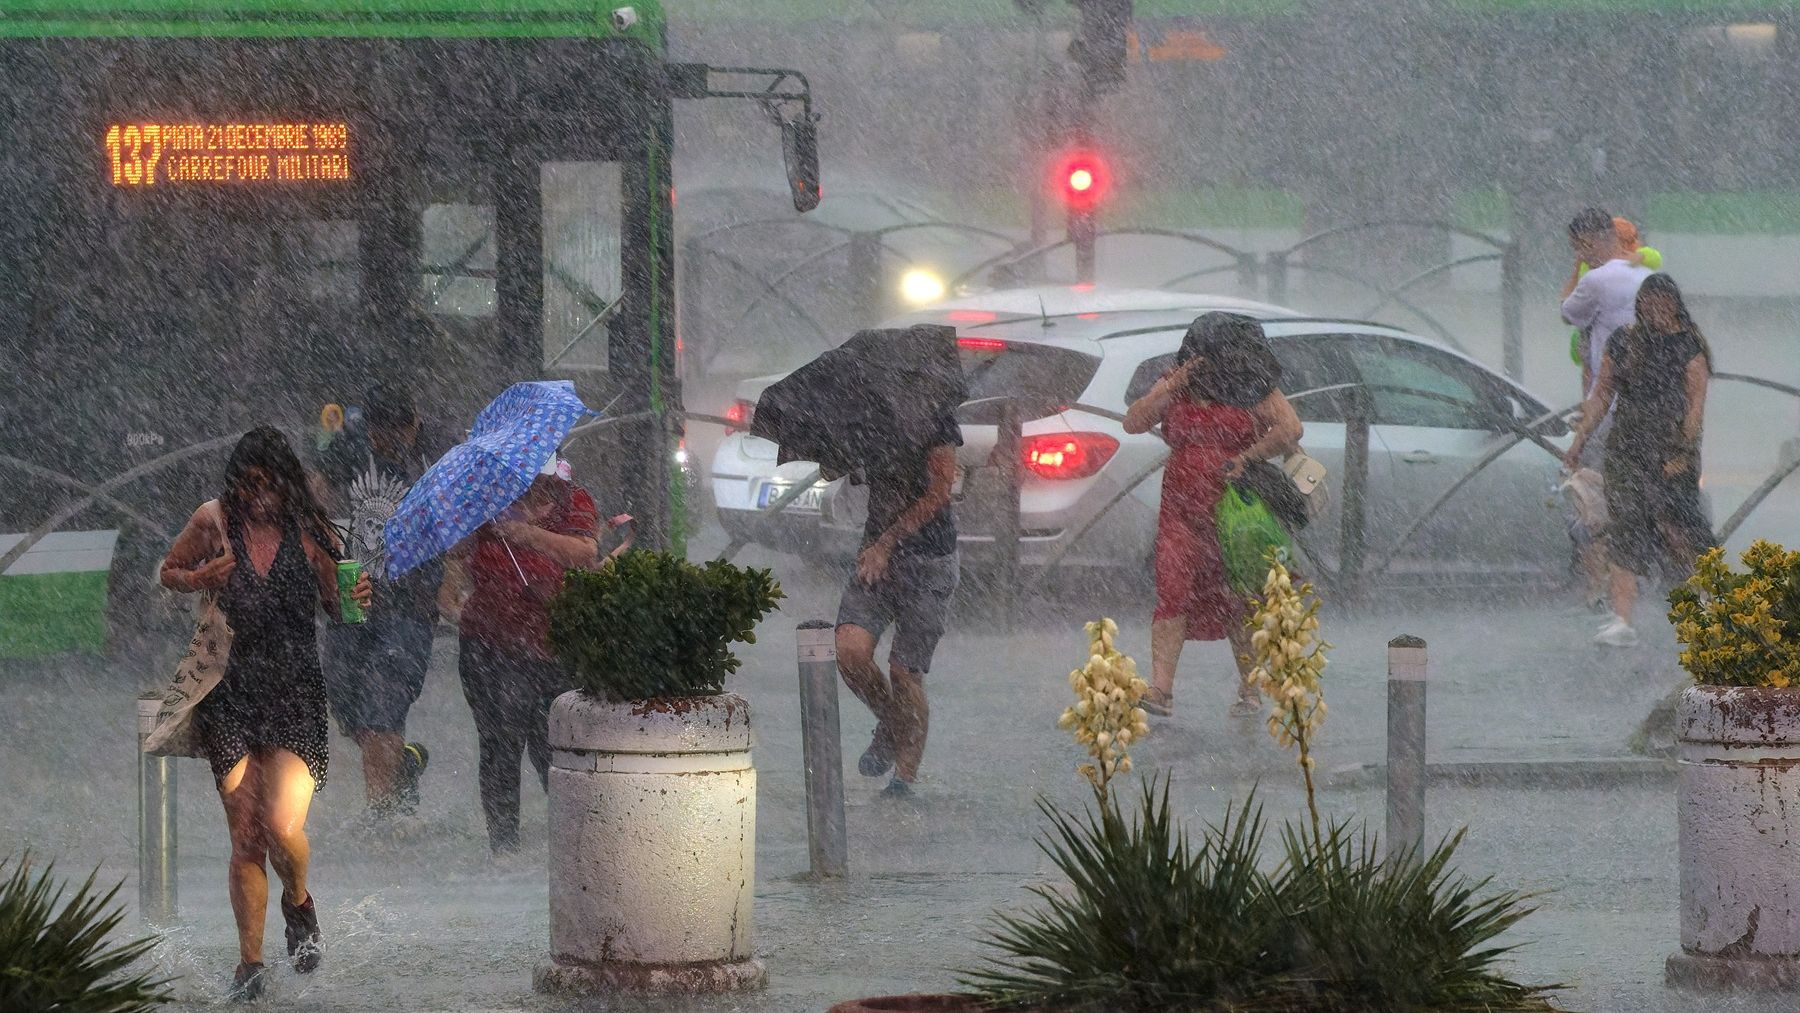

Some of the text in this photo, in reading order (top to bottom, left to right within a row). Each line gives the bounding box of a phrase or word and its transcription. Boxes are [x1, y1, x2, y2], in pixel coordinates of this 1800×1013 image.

[163, 124, 347, 149] PIATA 21 DECEMBRIE 1989
[106, 125, 161, 184] 137
[167, 154, 348, 180] CARREFOUR MILITARI
